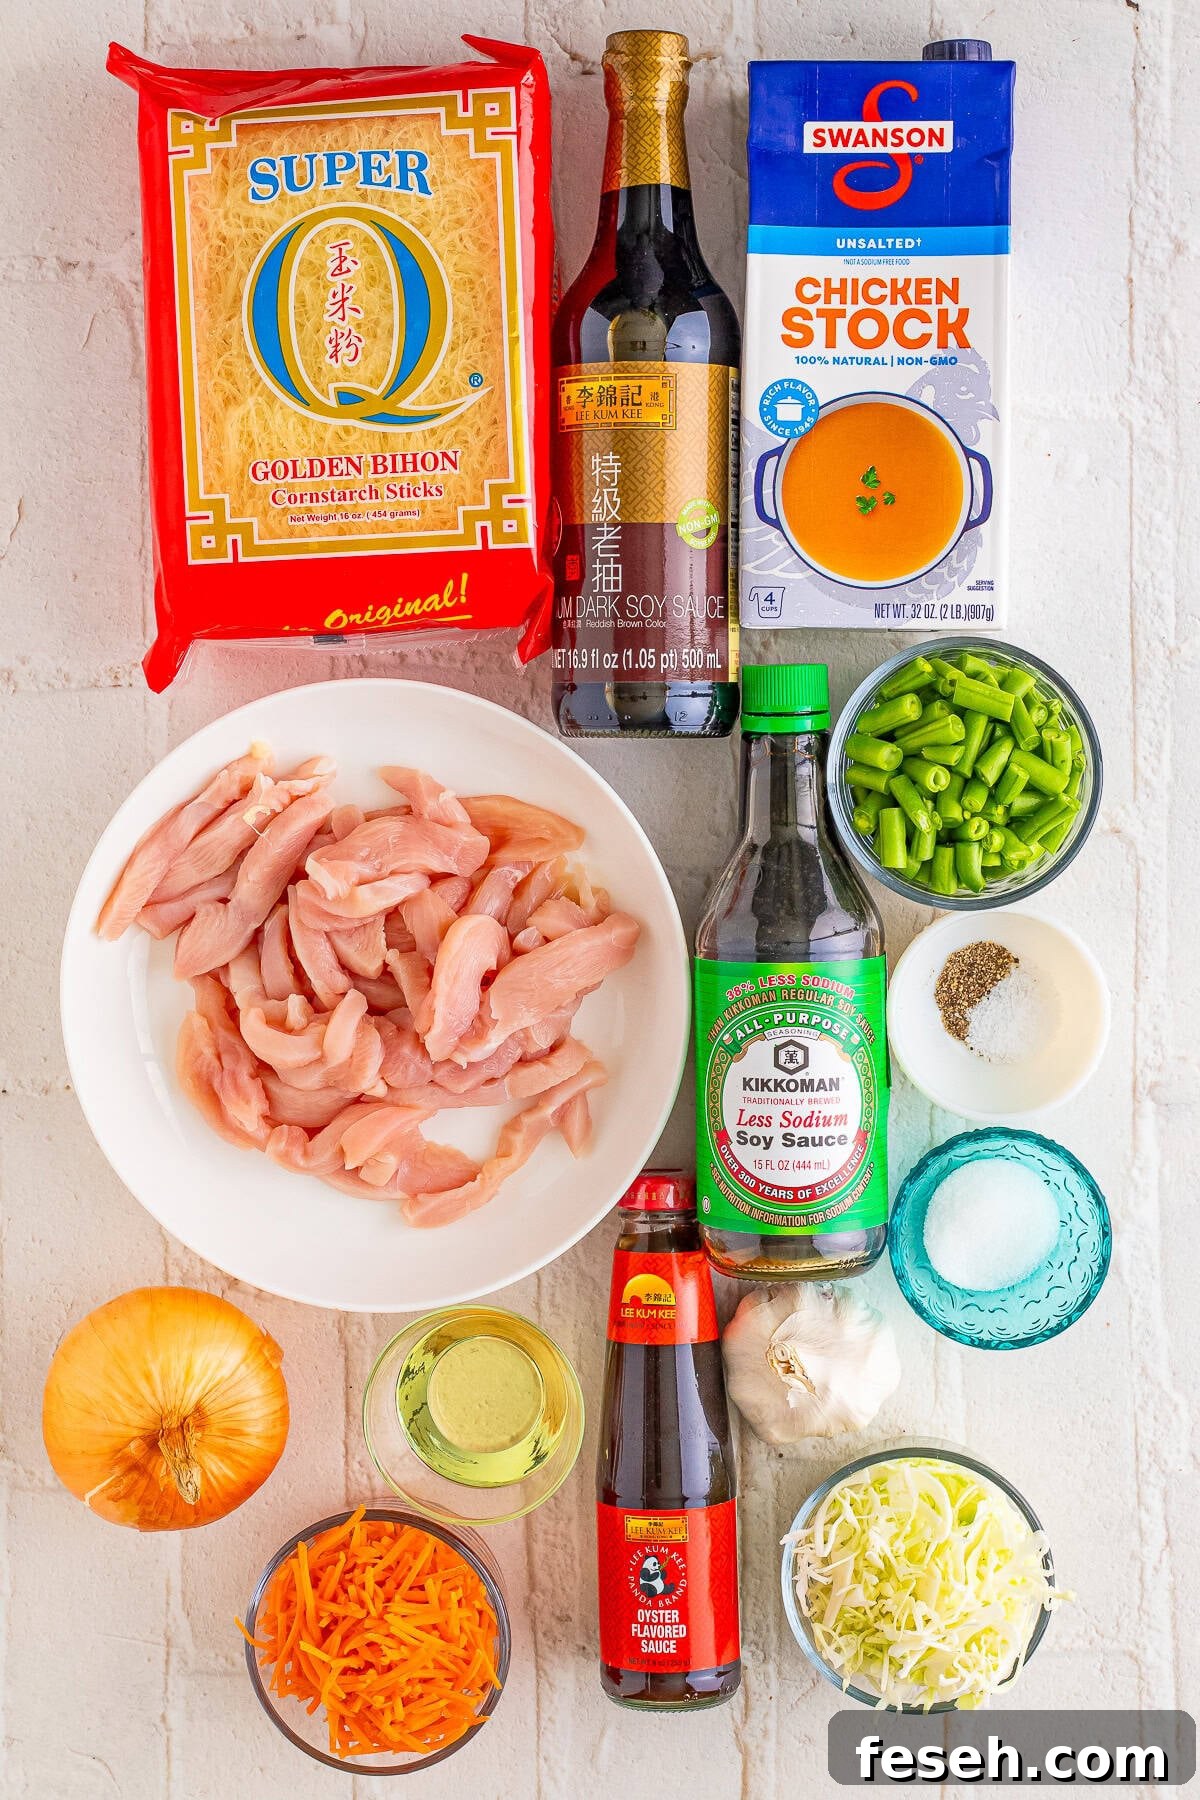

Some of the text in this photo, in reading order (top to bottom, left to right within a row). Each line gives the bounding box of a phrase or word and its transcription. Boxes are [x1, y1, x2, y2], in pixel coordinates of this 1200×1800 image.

[812, 127, 945, 148] SWANSON
[249, 149, 433, 204] SUPER
[861, 258, 882, 266] SODIUM
[882, 258, 895, 266] FREE
[895, 258, 911, 266] FOOD
[795, 276, 960, 306] CHICKEN
[326, 240, 365, 366] 玉米粉
[242, 202, 494, 432] Q
[780, 307, 972, 350] STOCK
[794, 355, 958, 367] 100% NATURAL NON-GMO
[576, 384, 642, 408] 李錦記
[763, 381, 816, 406] RICH FLAVOR
[575, 408, 642, 421] LEE KUM KEE
[764, 415, 814, 436] SINCE 1945
[251, 450, 460, 482] GOLDEN BIHON
[271, 482, 443, 507] Cornstarch Sticks
[290, 515, 304, 524] Net
[306, 513, 337, 523] Weight
[339, 512, 349, 522] 16
[351, 513, 364, 522] oz.
[390, 508, 420, 520] grams)
[591, 451, 623, 593] 特級老抽
[680, 513, 718, 533] NON-GM
[324, 572, 470, 631] Original!
[576, 595, 620, 618] DARK
[626, 594, 667, 618] SOY
[672, 595, 725, 619] SAUCE
[763, 592, 775, 605] 4
[874, 603, 890, 619] NET
[893, 603, 909, 619] WT.
[911, 603, 921, 619] 32
[924, 603, 938, 619] OZ.
[940, 603, 948, 621] (2
[586, 619, 667, 628] Reddish Brown Color
[568, 648, 588, 669] 16.9
[591, 648, 599, 668] fl
[603, 653, 619, 669] oz
[623, 648, 656, 670] (1.05
[661, 648, 678, 673] pt)
[682, 648, 704, 669] 500
[706, 648, 721, 669] mL
[726, 974, 855, 1001] 38% LESS SODIUM
[707, 988, 876, 1045] THAN KIKKOMAN REGULAR SOY SAUCE
[766, 1028, 818, 1038] SEASONING
[742, 1077, 840, 1093] KIKKOMAN
[742, 1096, 841, 1106] TRADITIONALLY BREWED
[736, 1108, 848, 1129] Less Sodium
[736, 1130, 848, 1150] Soy Sauce
[720, 1144, 864, 1200] OVER 300 YEARS OF EXCELLENCE
[753, 1159, 831, 1172] 15 FL OZ (444 mL)
[711, 1167, 875, 1227] SEE NUTRITION INFORMATION FOR SODIUM CONTENT
[621, 1308, 677, 1319] LEE KUM KEE
[630, 1545, 686, 1571] LEE KUM KEE
[628, 1575, 687, 1608] PANDA BRAND
[637, 1609, 679, 1623] OYSTER
[631, 1623, 687, 1639] FLAVORED
[641, 1639, 677, 1654] SAUCE
